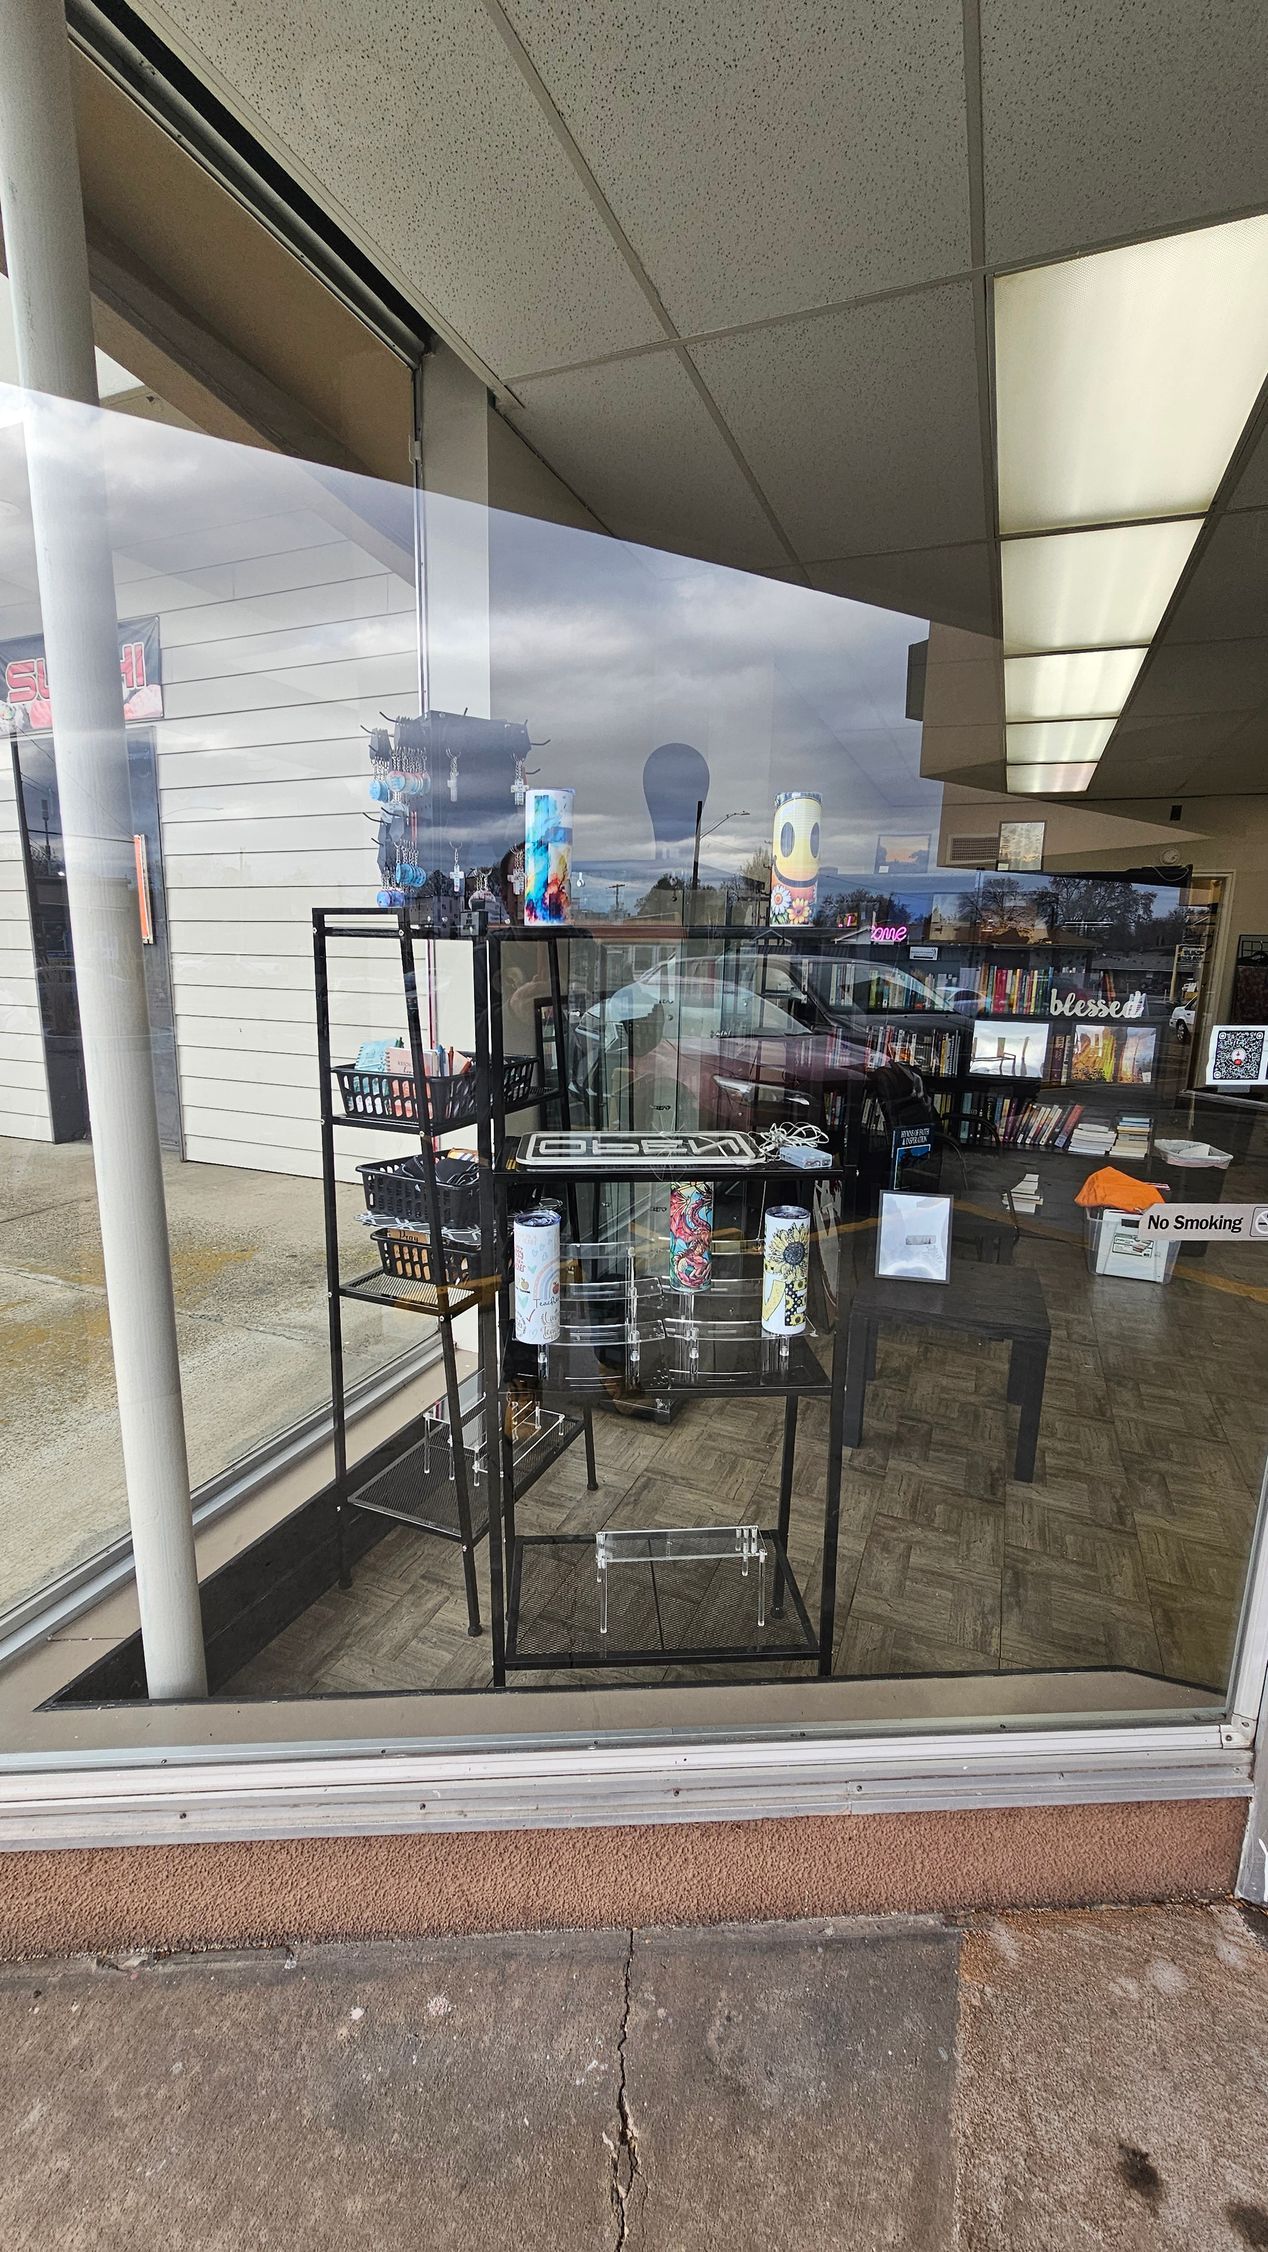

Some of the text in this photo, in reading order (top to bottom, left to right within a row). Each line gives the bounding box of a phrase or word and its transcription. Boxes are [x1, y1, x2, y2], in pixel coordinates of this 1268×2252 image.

[1049, 988, 1145, 1018] blessed
[1147, 1214, 1244, 1233] No Smoking
